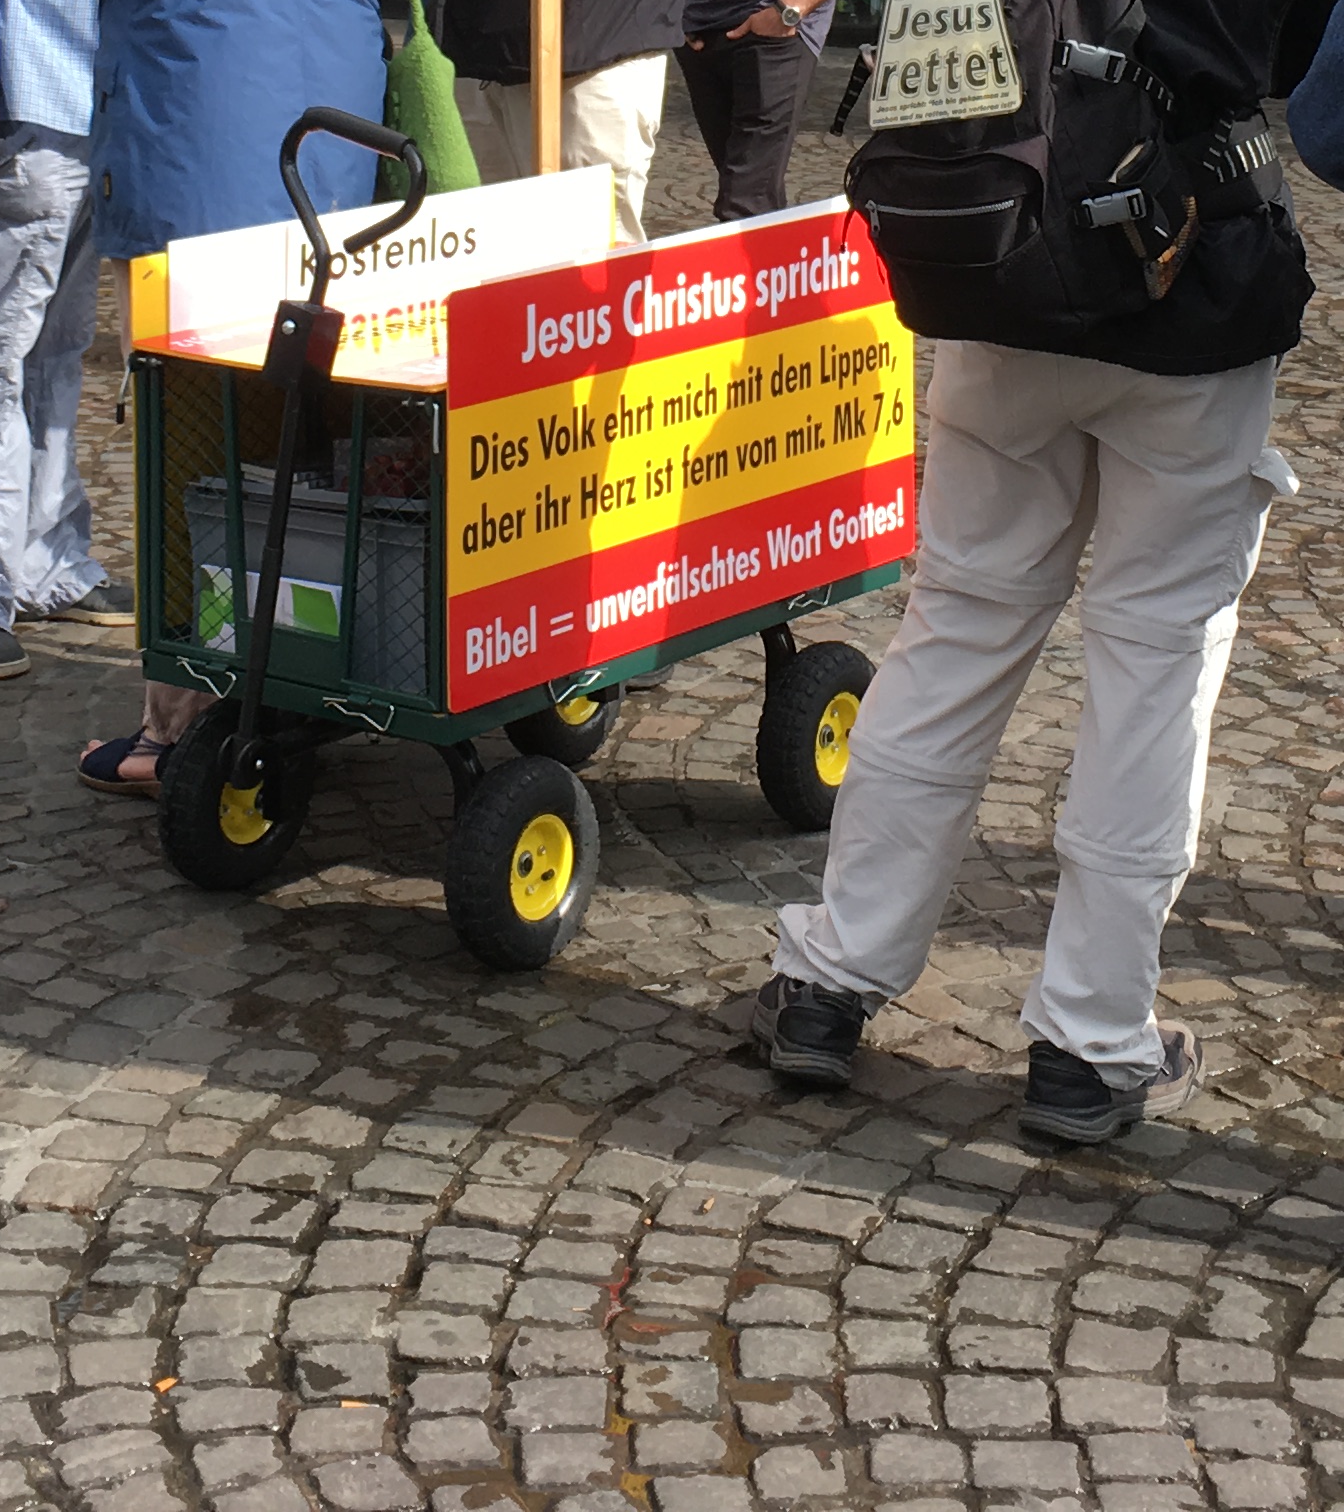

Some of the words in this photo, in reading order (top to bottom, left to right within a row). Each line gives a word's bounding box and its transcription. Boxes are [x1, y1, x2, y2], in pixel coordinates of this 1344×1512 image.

[878, 42, 1008, 98] rettet
[888, 3, 993, 42] Jesus
[300, 217, 478, 287] Kostenlos
[521, 302, 612, 364] Jesus
[622, 270, 747, 338] Christus
[754, 235, 860, 318] spricht:
[462, 502, 526, 555] aber
[535, 484, 571, 535] ihr
[580, 472, 636, 523] Herz
[645, 458, 674, 499] ist
[682, 443, 729, 494] fern
[737, 433, 778, 473] von
[785, 414, 826, 460] mir.
[833, 395, 867, 441] Mk
[872, 387, 904, 438] 7,6
[470, 430, 529, 481] Dies
[537, 405, 596, 461] Volk
[604, 393, 654, 442] ehrt
[662, 373, 718, 429] mich
[725, 352, 763, 412] mit
[770, 352, 812, 400] den
[820, 338, 898, 387] Lippen,
[465, 604, 538, 675] Bibel
[549, 610, 574, 638] =
[585, 543, 761, 633] unverfälschtes
[767, 520, 822, 571] Wort
[828, 487, 905, 550] Gottes!
